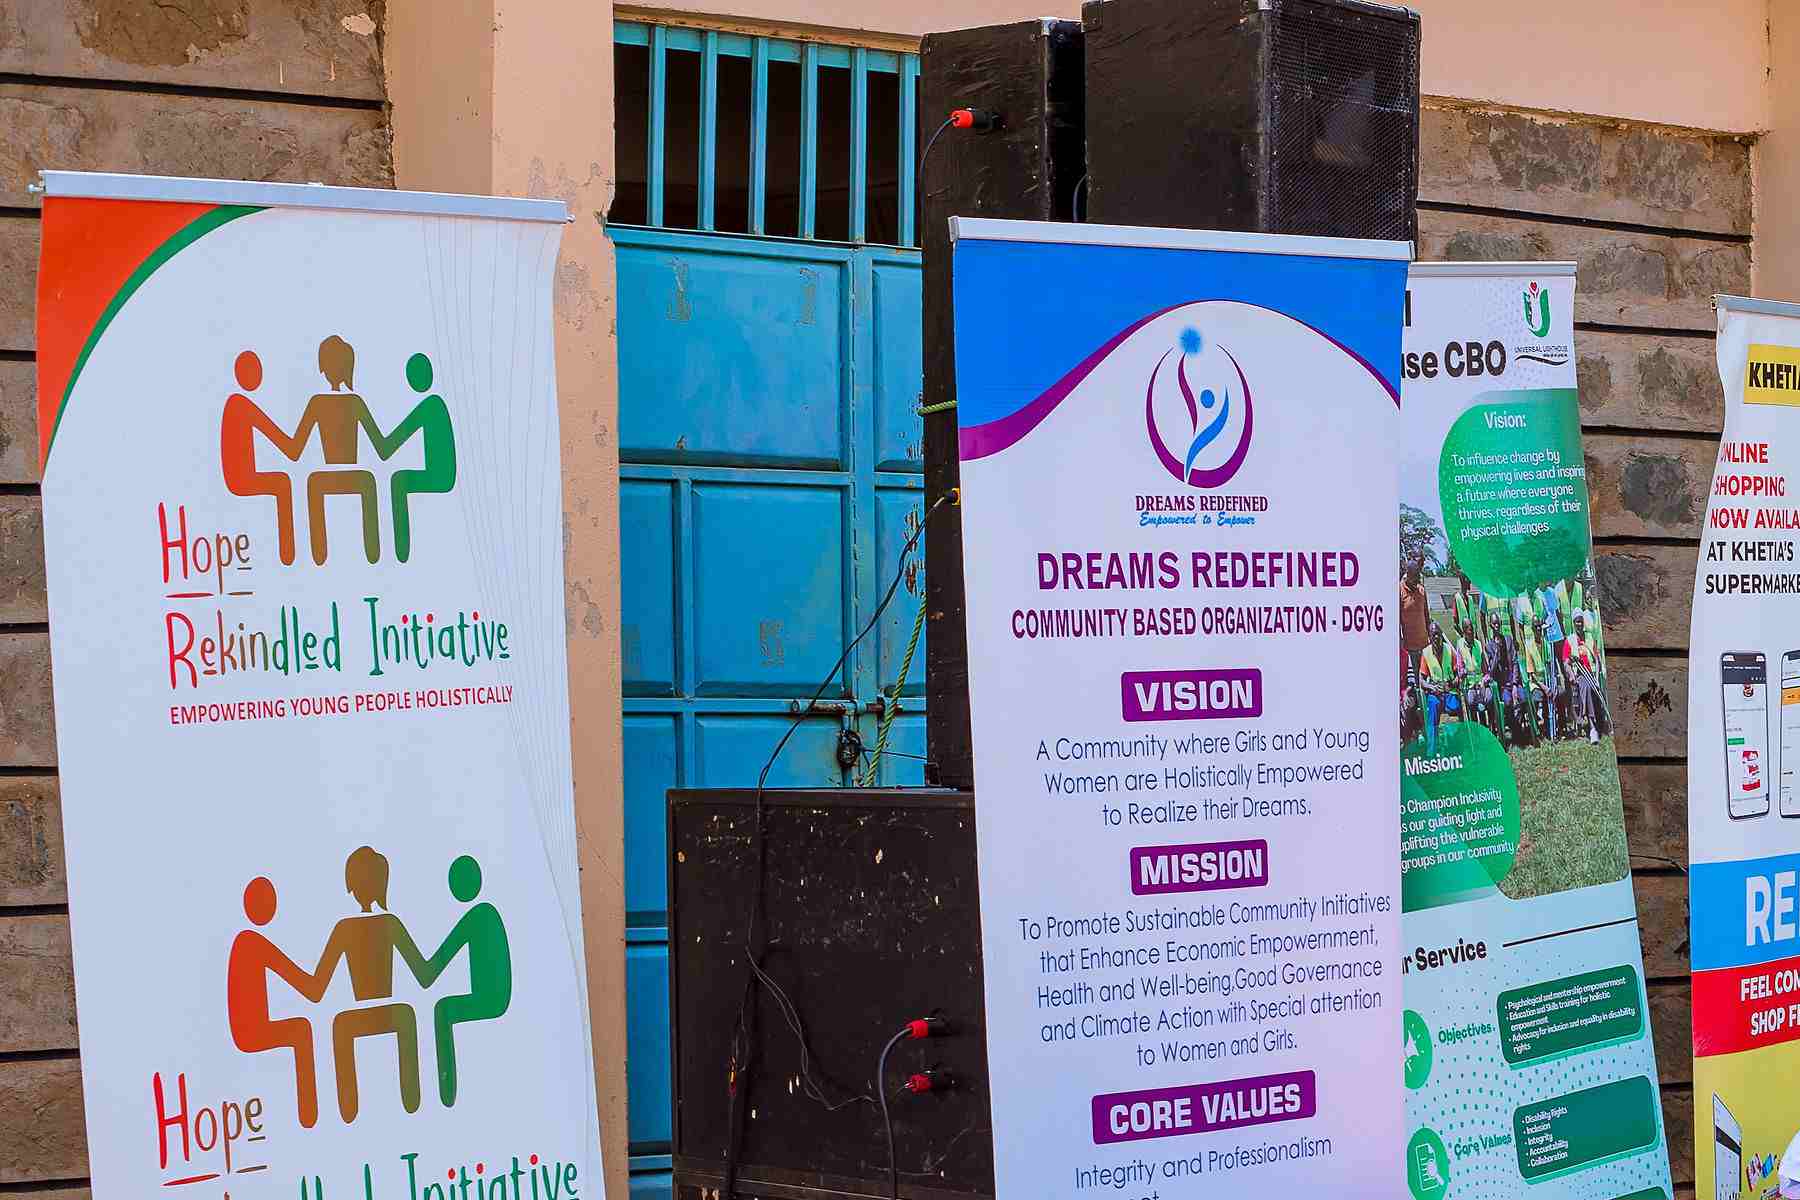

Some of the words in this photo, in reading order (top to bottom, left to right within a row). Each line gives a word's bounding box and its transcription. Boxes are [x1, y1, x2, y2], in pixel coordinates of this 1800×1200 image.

[1444, 340, 1507, 378] CBO
[1483, 411, 1527, 430] Vision:
[1714, 475, 1785, 496] SHOPPING
[1135, 495, 1195, 511] DREAMS
[1200, 495, 1268, 512] REDEFINED
[1139, 511, 1197, 527] Empowered
[1202, 513, 1212, 525] to
[1217, 511, 1256, 527] Empower
[1710, 509, 1749, 529] NOW
[158, 502, 253, 594] Hope
[1707, 542, 1728, 561] AT
[1732, 541, 1794, 561] KHETIA'S
[1037, 551, 1180, 590] DREAMS
[1192, 550, 1359, 587] REDEFINED
[1011, 607, 1128, 639] COMMUNITY
[1133, 607, 1197, 637] BASED
[1201, 604, 1327, 635] ORGANIZATION
[1342, 604, 1384, 633] DGYG
[166, 601, 341, 689] Rekindled
[364, 597, 510, 676] Initiative
[170, 700, 285, 725] EMPOWERING
[291, 694, 349, 718] YOUNG
[355, 690, 412, 711] PEOPLE
[416, 685, 513, 708] HOLISTICALLY
[1134, 679, 1254, 713] VISION
[1036, 739, 1051, 761] A
[1055, 733, 1168, 761] Community
[1174, 732, 1230, 755] where
[1234, 731, 1266, 752] Girls
[1271, 729, 1307, 751] and
[1313, 727, 1370, 752] Young
[1405, 755, 1462, 776] Mission:
[1140, 848, 1263, 885] MISSION
[1417, 939, 1487, 973] Service
[1740, 976, 1773, 1001] FEEL
[1438, 1023, 1492, 1044] Objectives
[1750, 1008, 1786, 1036] SHOP
[153, 1072, 267, 1175] Hope
[1109, 1097, 1192, 1135] CORE
[1201, 1083, 1302, 1123] VALUES
[1075, 1156, 1156, 1189] Integrity
[1163, 1152, 1202, 1177] and
[1208, 1135, 1332, 1172] Professionalism
